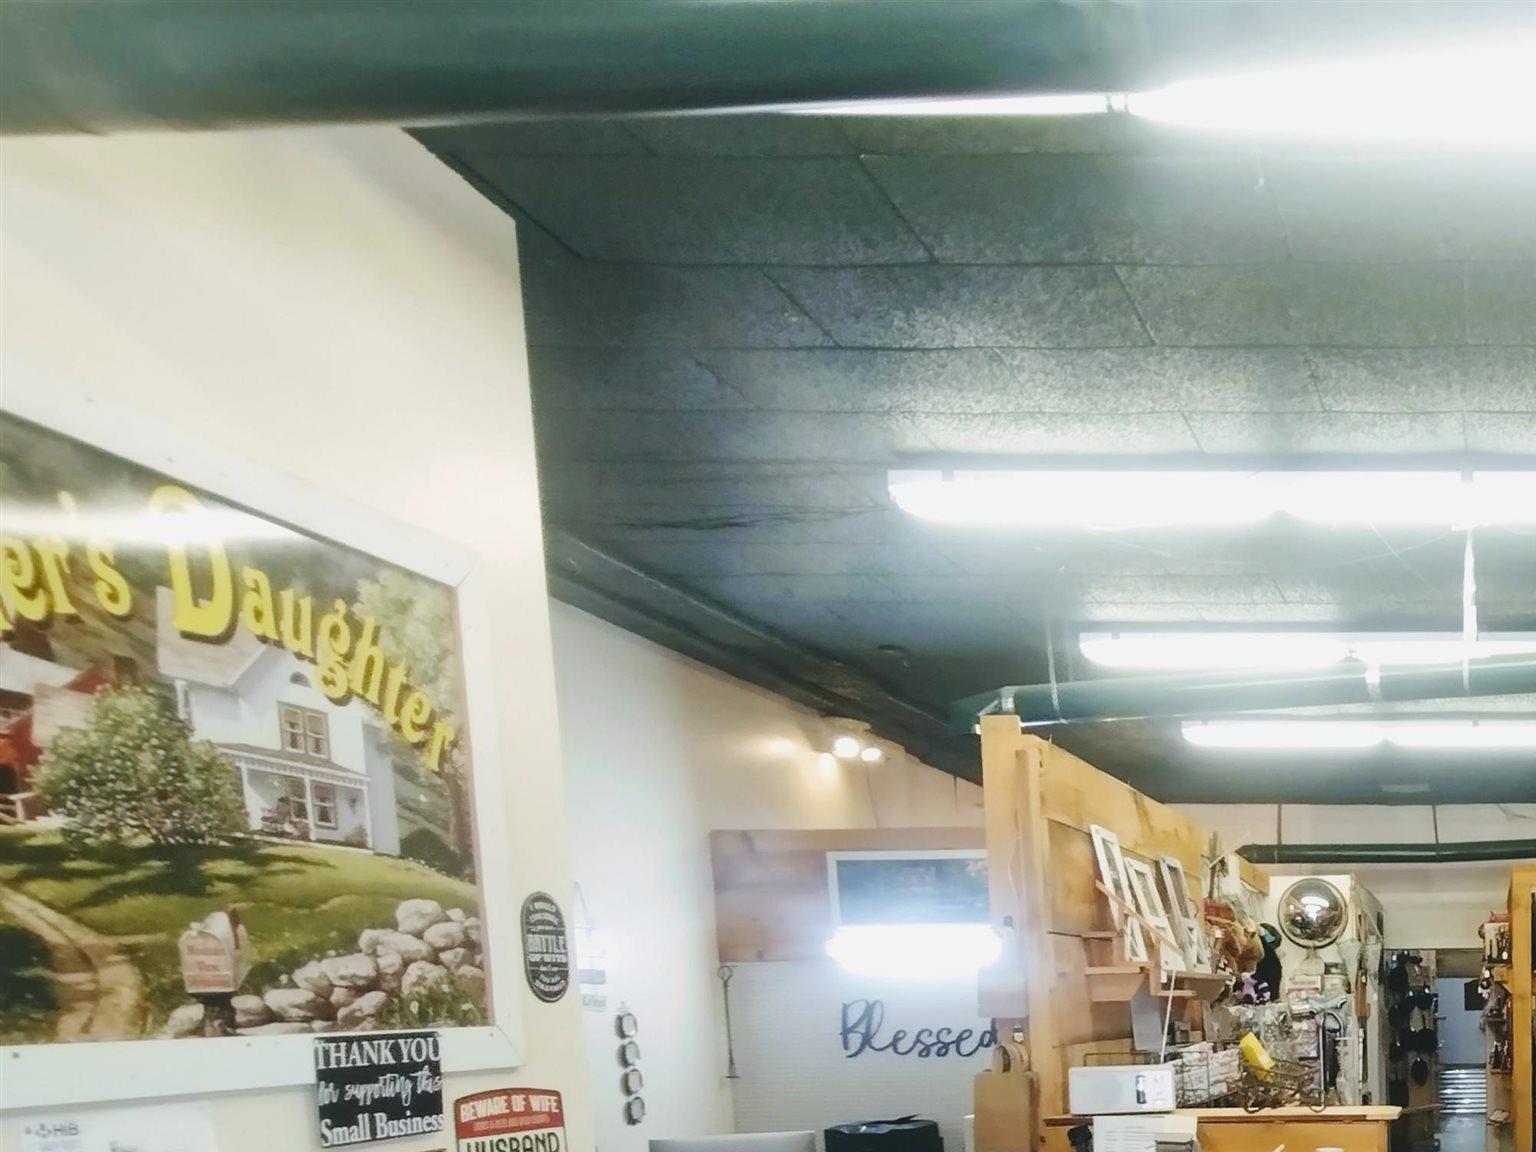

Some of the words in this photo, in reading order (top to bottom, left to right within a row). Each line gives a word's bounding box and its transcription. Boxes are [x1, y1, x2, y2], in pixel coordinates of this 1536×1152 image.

[0, 489, 132, 631] er's
[152, 485, 456, 771] Daughter
[840, 998, 998, 1059] Blessed
[314, 1039, 396, 1070] THANK
[397, 1036, 441, 1063] YOU
[344, 1072, 412, 1107] supporting
[459, 1096, 510, 1123] BEWARE
[512, 1094, 527, 1112] OF
[528, 1094, 560, 1113] WIFE
[320, 1112, 372, 1148] Small
[373, 1110, 445, 1139] Business
